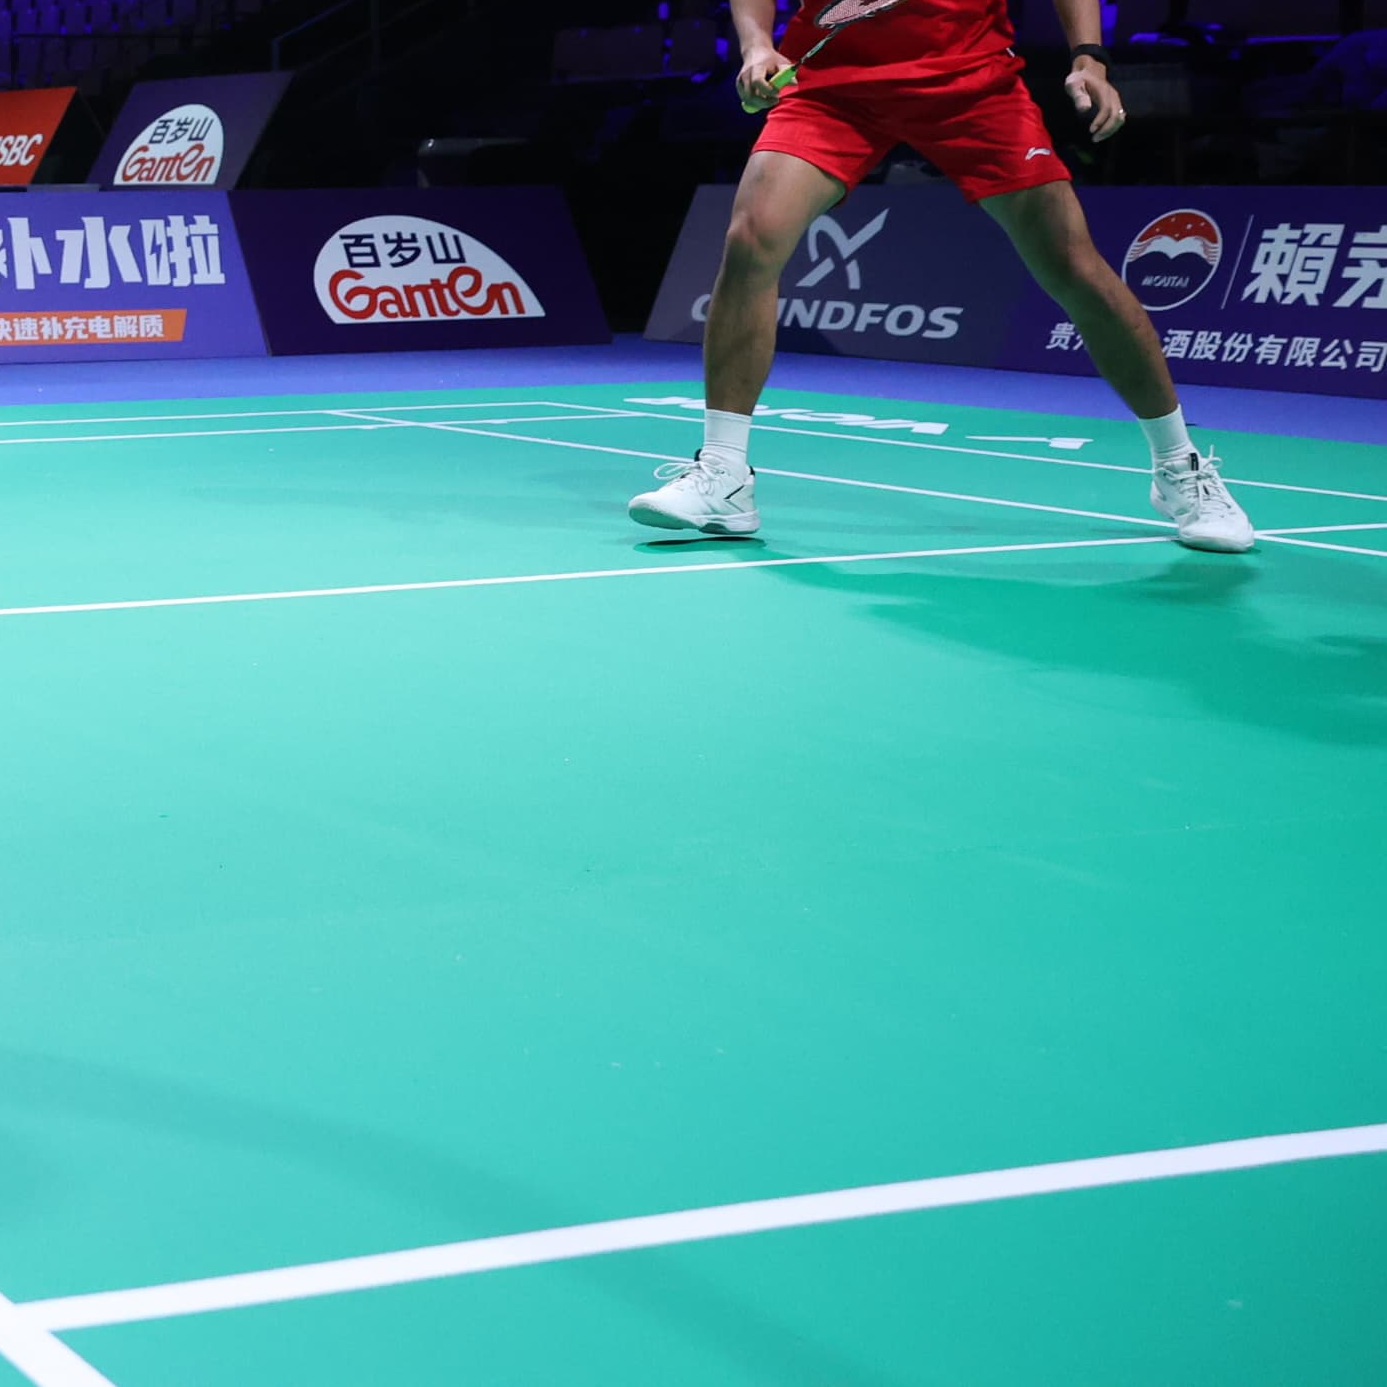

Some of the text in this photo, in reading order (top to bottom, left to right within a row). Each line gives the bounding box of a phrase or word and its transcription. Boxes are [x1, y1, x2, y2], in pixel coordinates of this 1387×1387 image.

[148, 116, 214, 145] 百岁山
[339, 230, 467, 269] 百岁山
